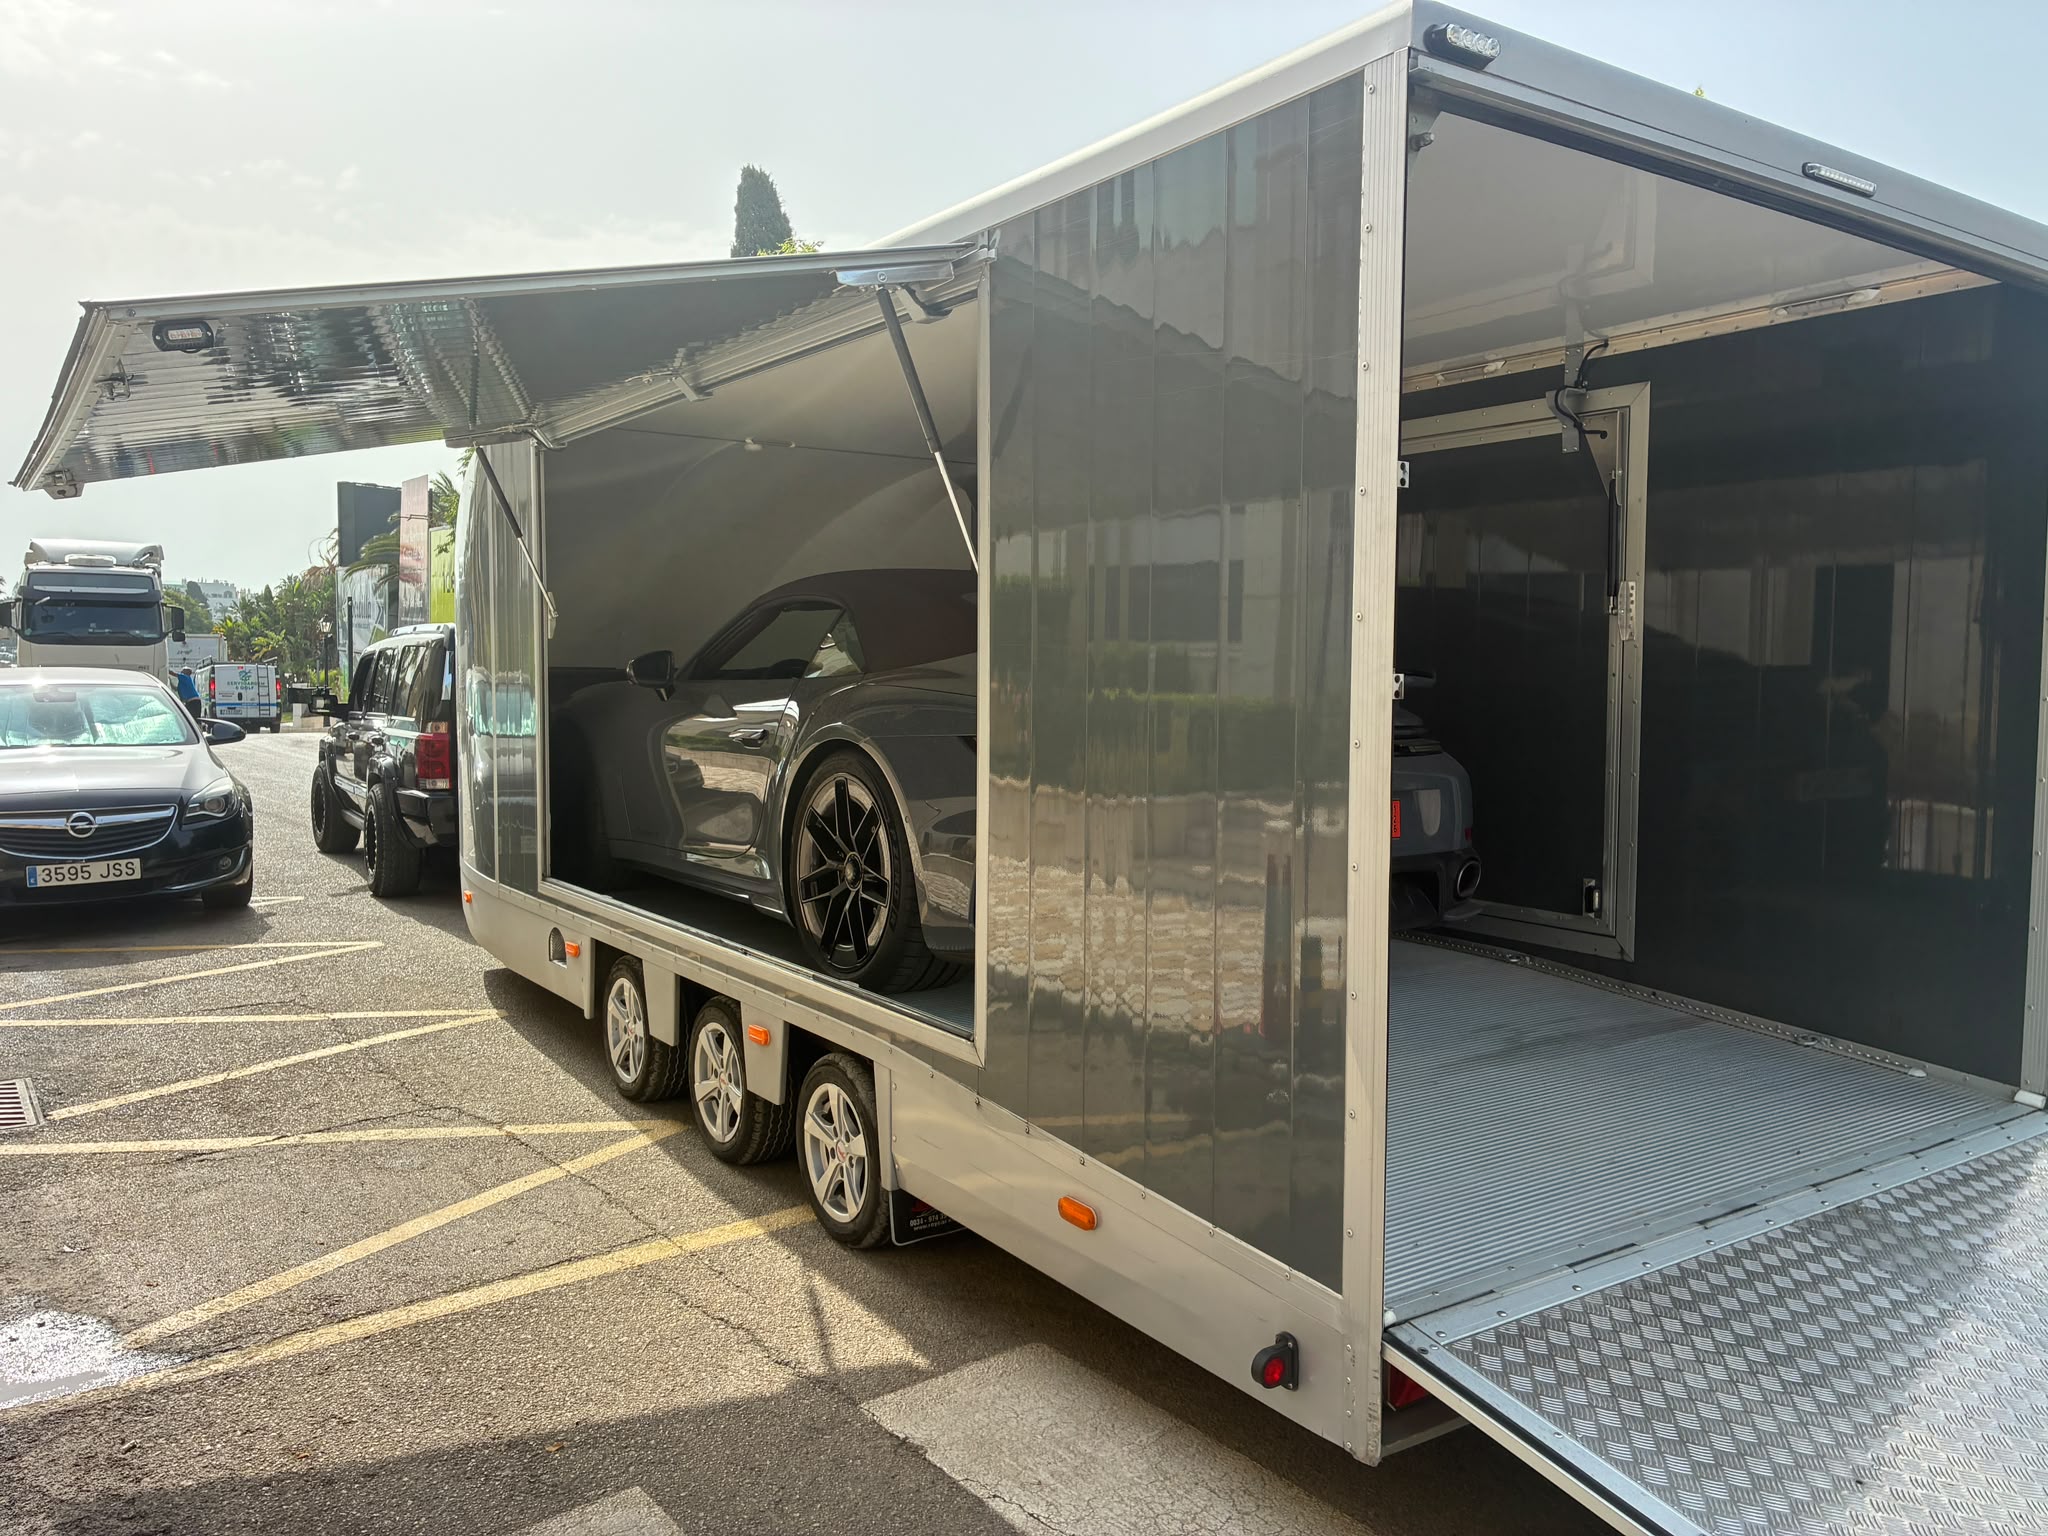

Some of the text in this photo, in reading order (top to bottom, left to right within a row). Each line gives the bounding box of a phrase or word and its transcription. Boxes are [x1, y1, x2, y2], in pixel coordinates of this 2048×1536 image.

[41, 861, 136, 883] 3595 JSS
[910, 1218, 924, 1227] 0034
